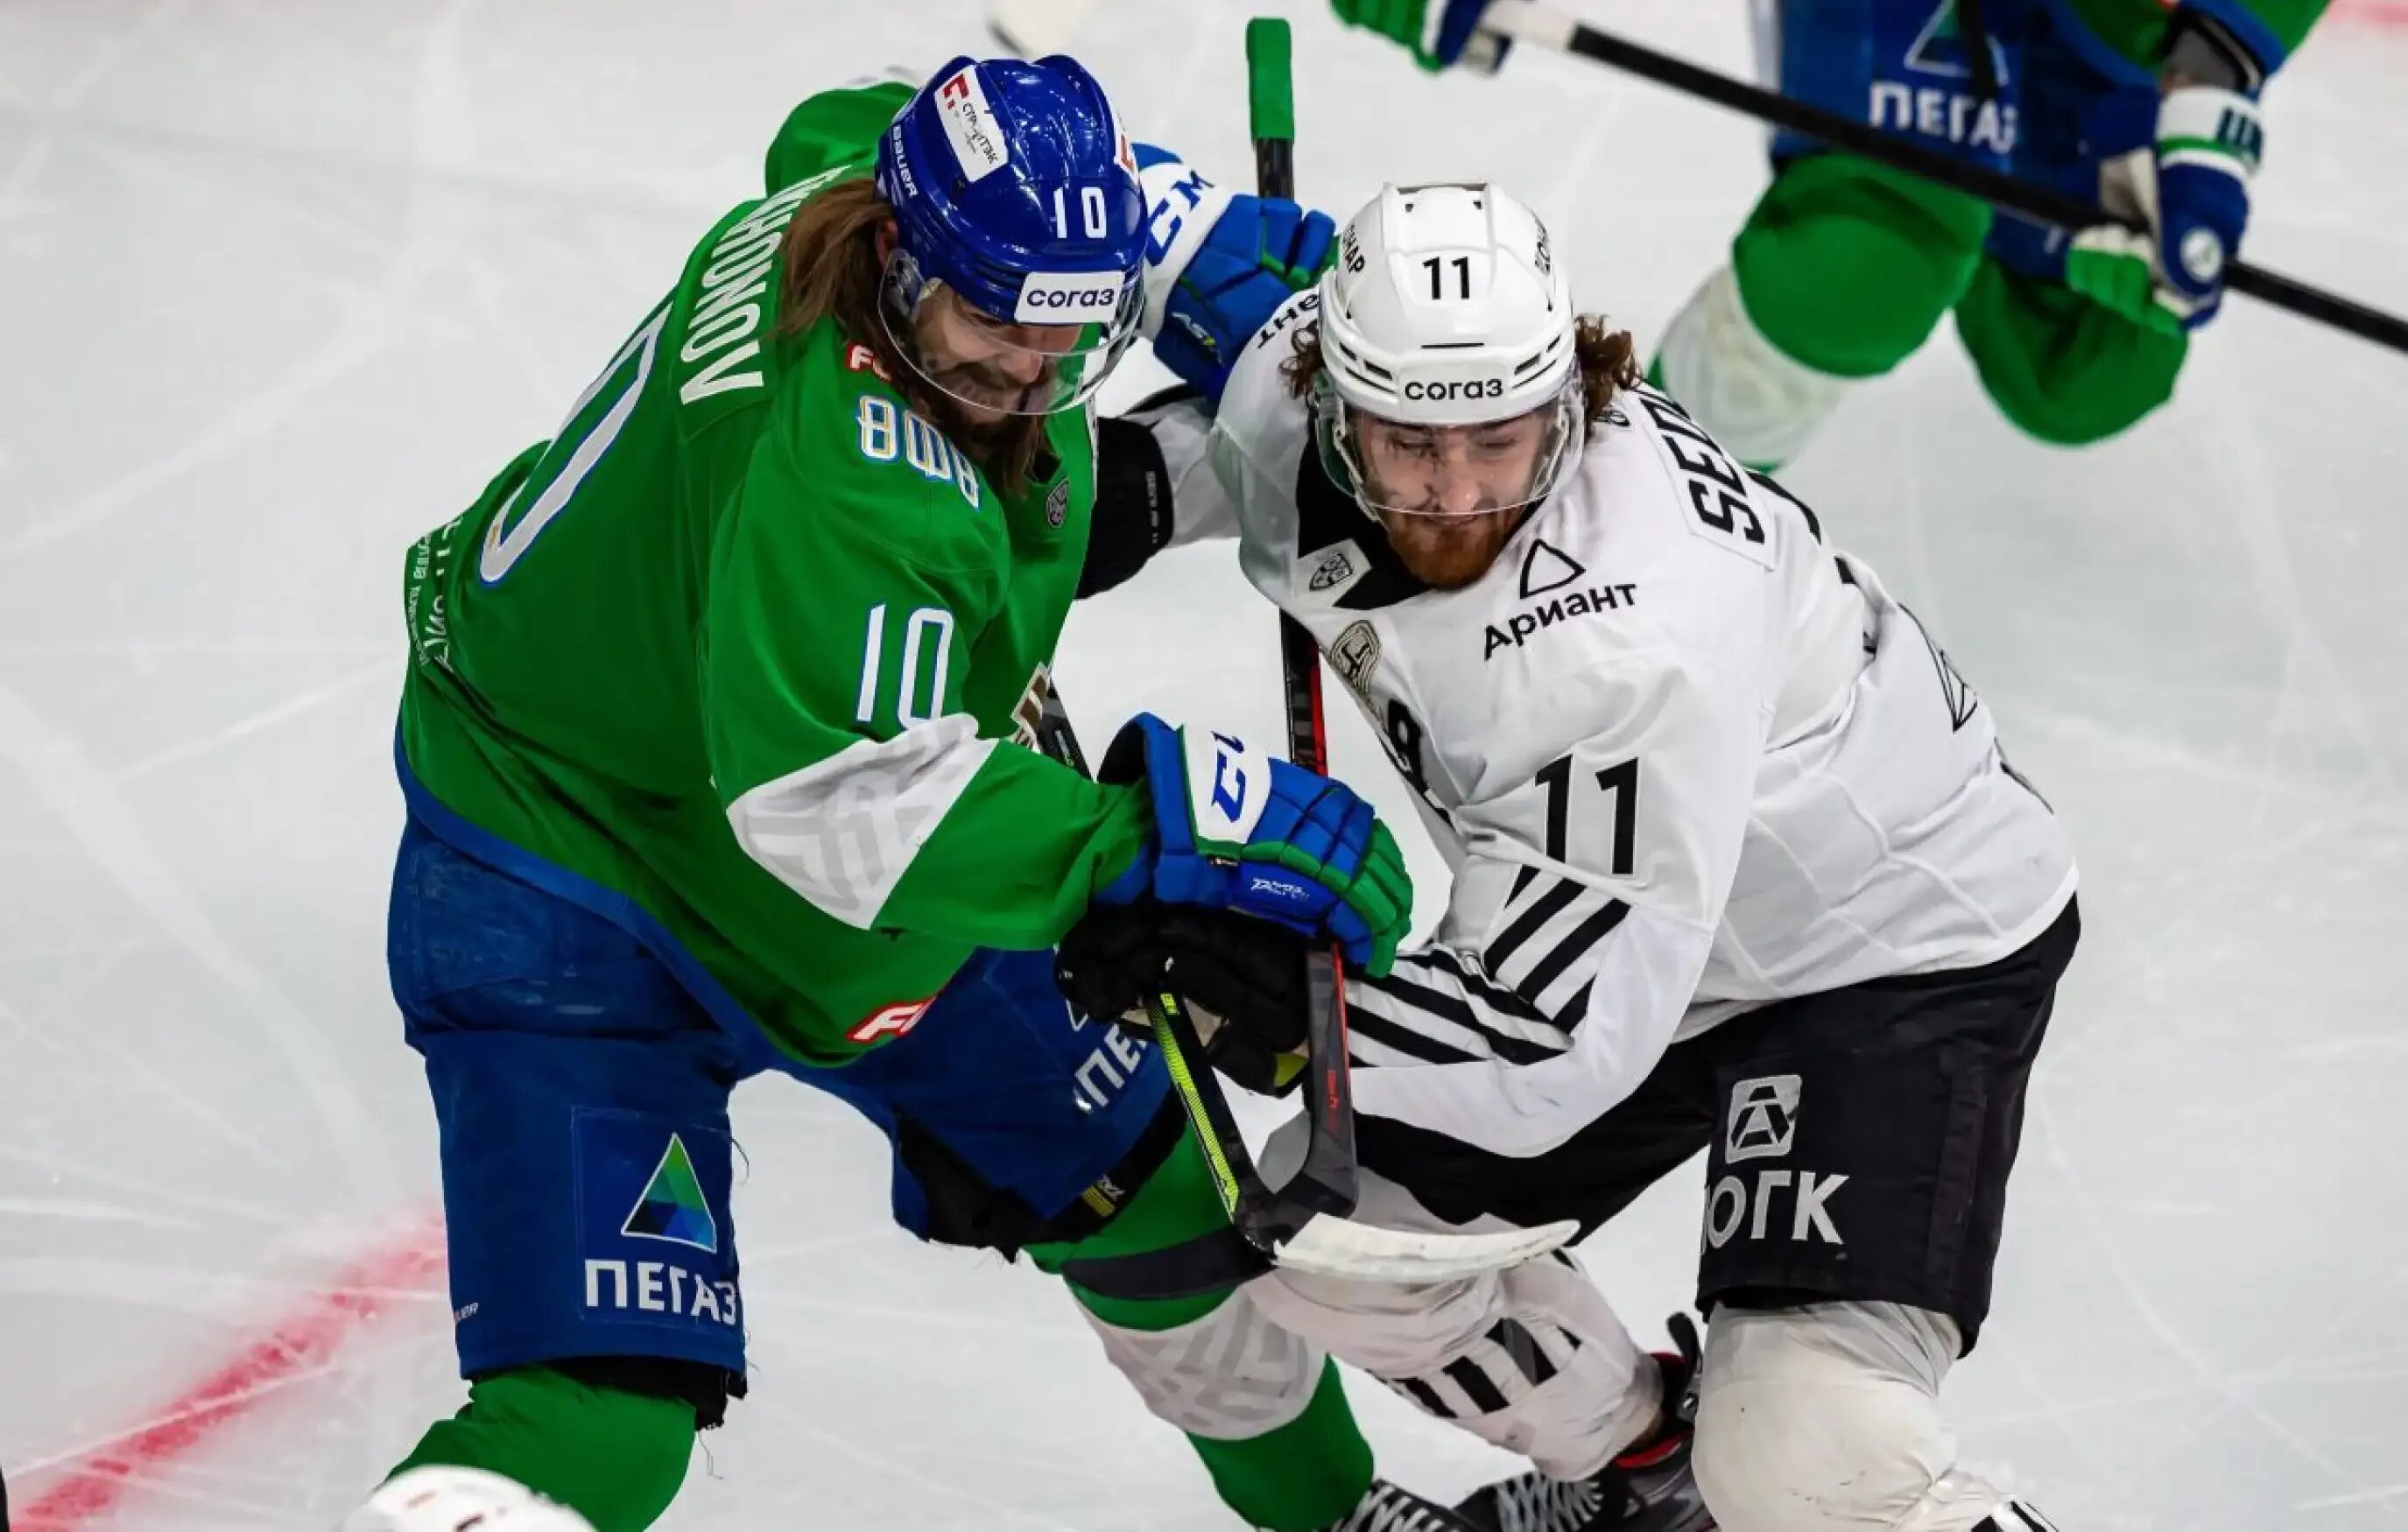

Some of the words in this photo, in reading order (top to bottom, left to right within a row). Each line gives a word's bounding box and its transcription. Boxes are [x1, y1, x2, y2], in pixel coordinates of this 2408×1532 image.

[1053, 186, 1106, 238] 10
[1026, 288, 1115, 307] согаз
[1422, 257, 1470, 299] 11
[1405, 379, 1503, 400] согаз
[1483, 583, 1638, 658] Ариант
[855, 604, 954, 728] 10
[1536, 754, 1638, 875] 11
[585, 1260, 736, 1326] ПЕГАЗ
